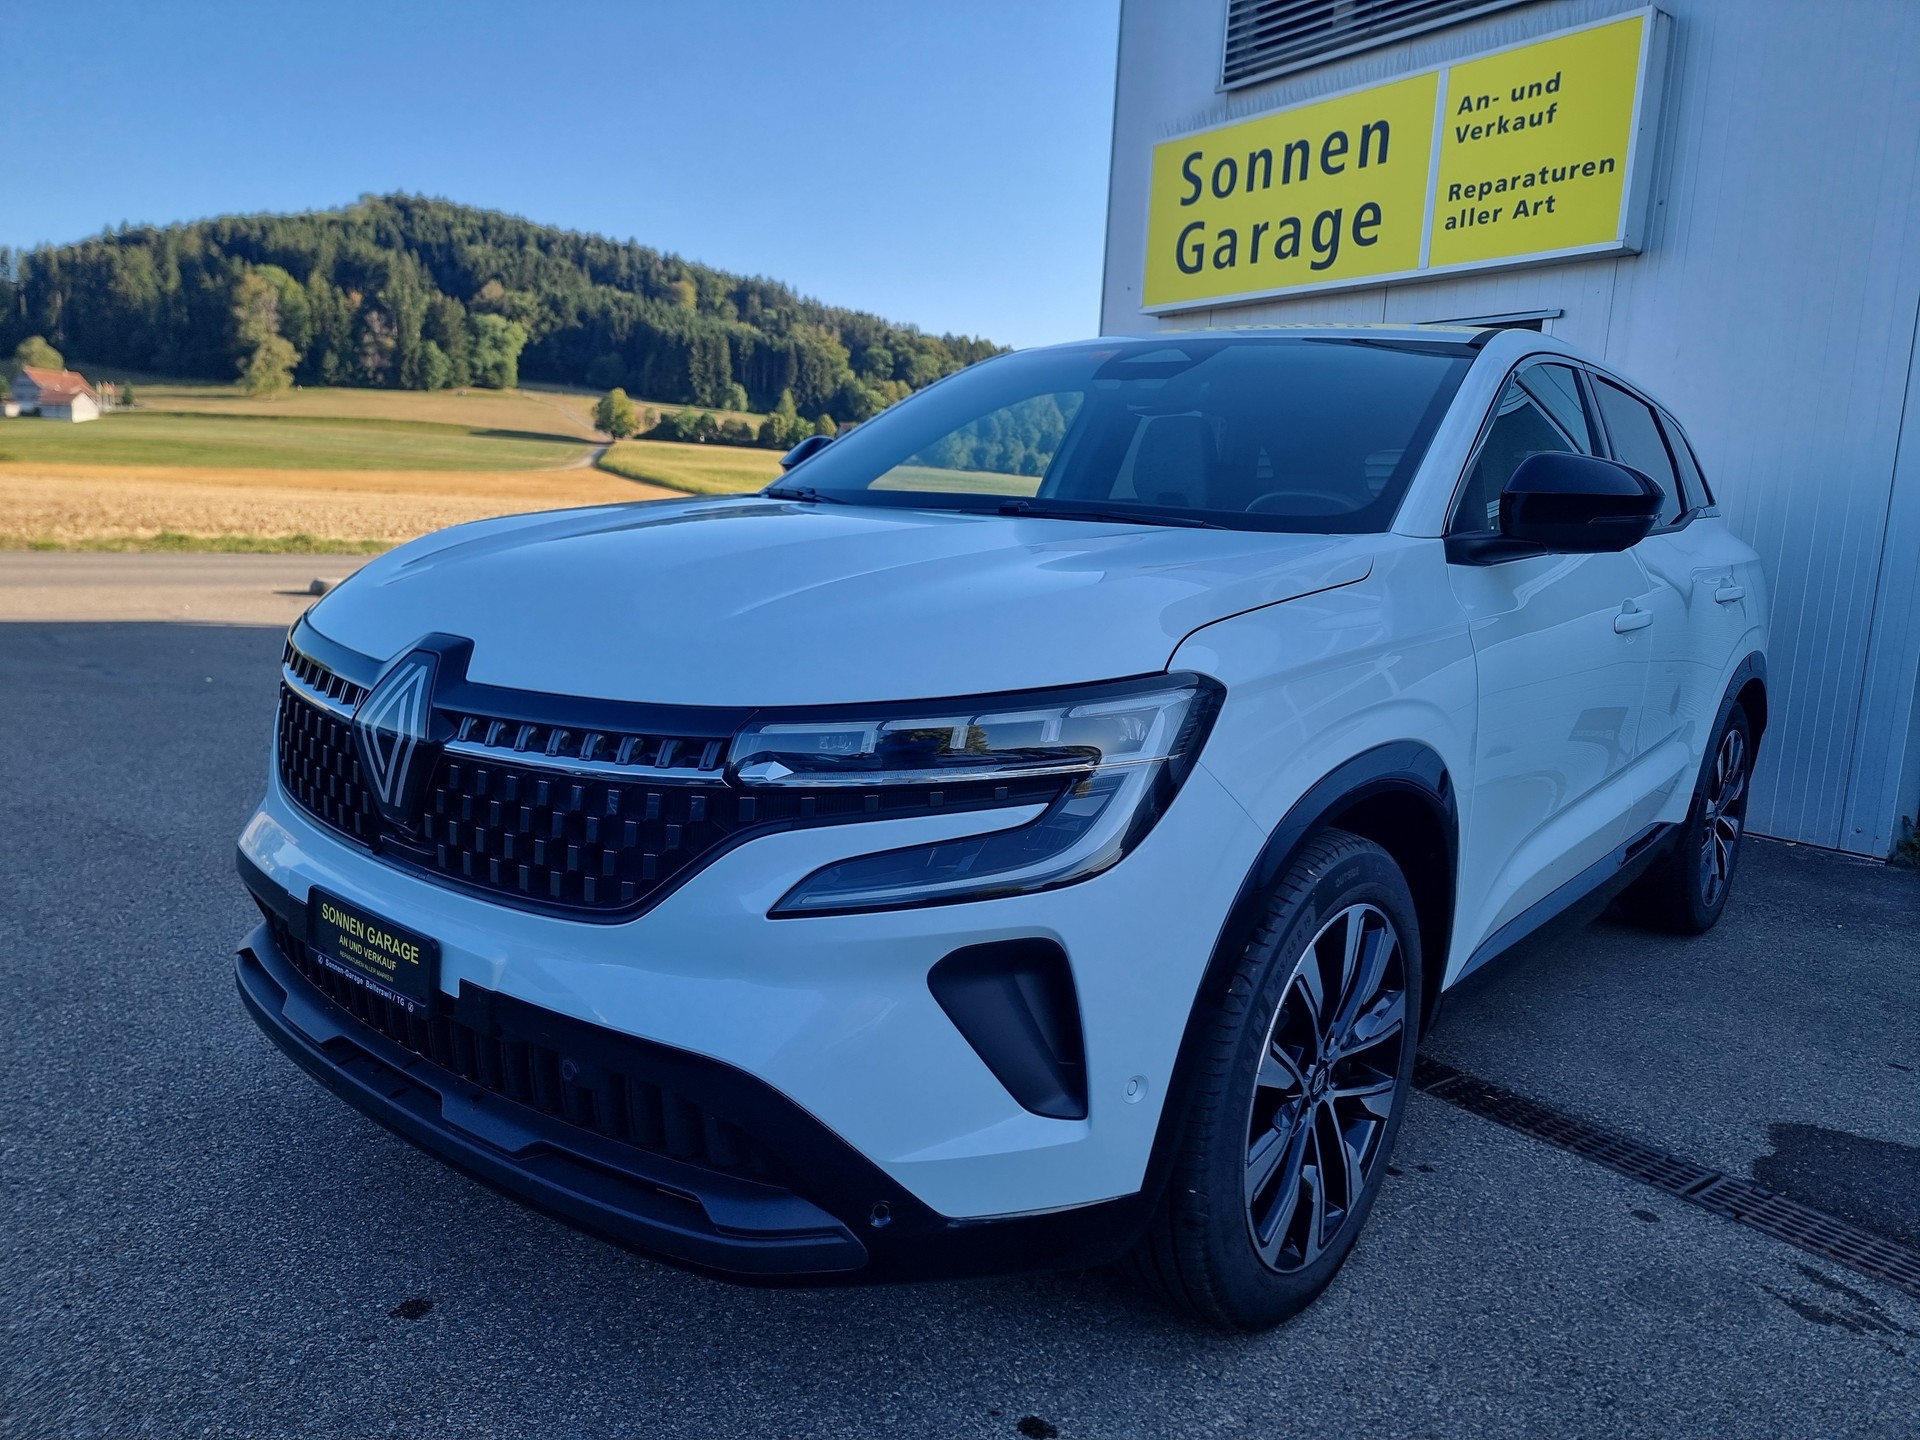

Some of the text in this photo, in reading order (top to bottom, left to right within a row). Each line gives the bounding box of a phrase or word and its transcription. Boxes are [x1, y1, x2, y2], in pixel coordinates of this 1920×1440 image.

[1457, 72, 1562, 115] An- und
[1455, 102, 1558, 143] Verkauf
[1179, 119, 1390, 207] Sonnen
[1448, 157, 1615, 202] Reparaturen
[1444, 194, 1556, 231] aller Art
[1175, 201, 1382, 275] Garage
[322, 903, 419, 964] SONNEN GARAGE
[339, 935, 397, 970] AN UND VERKAUF
[325, 958, 363, 985] Sonnen-Garage
[396, 995, 405, 1007] TG
[364, 963, 376, 974] ALLER
